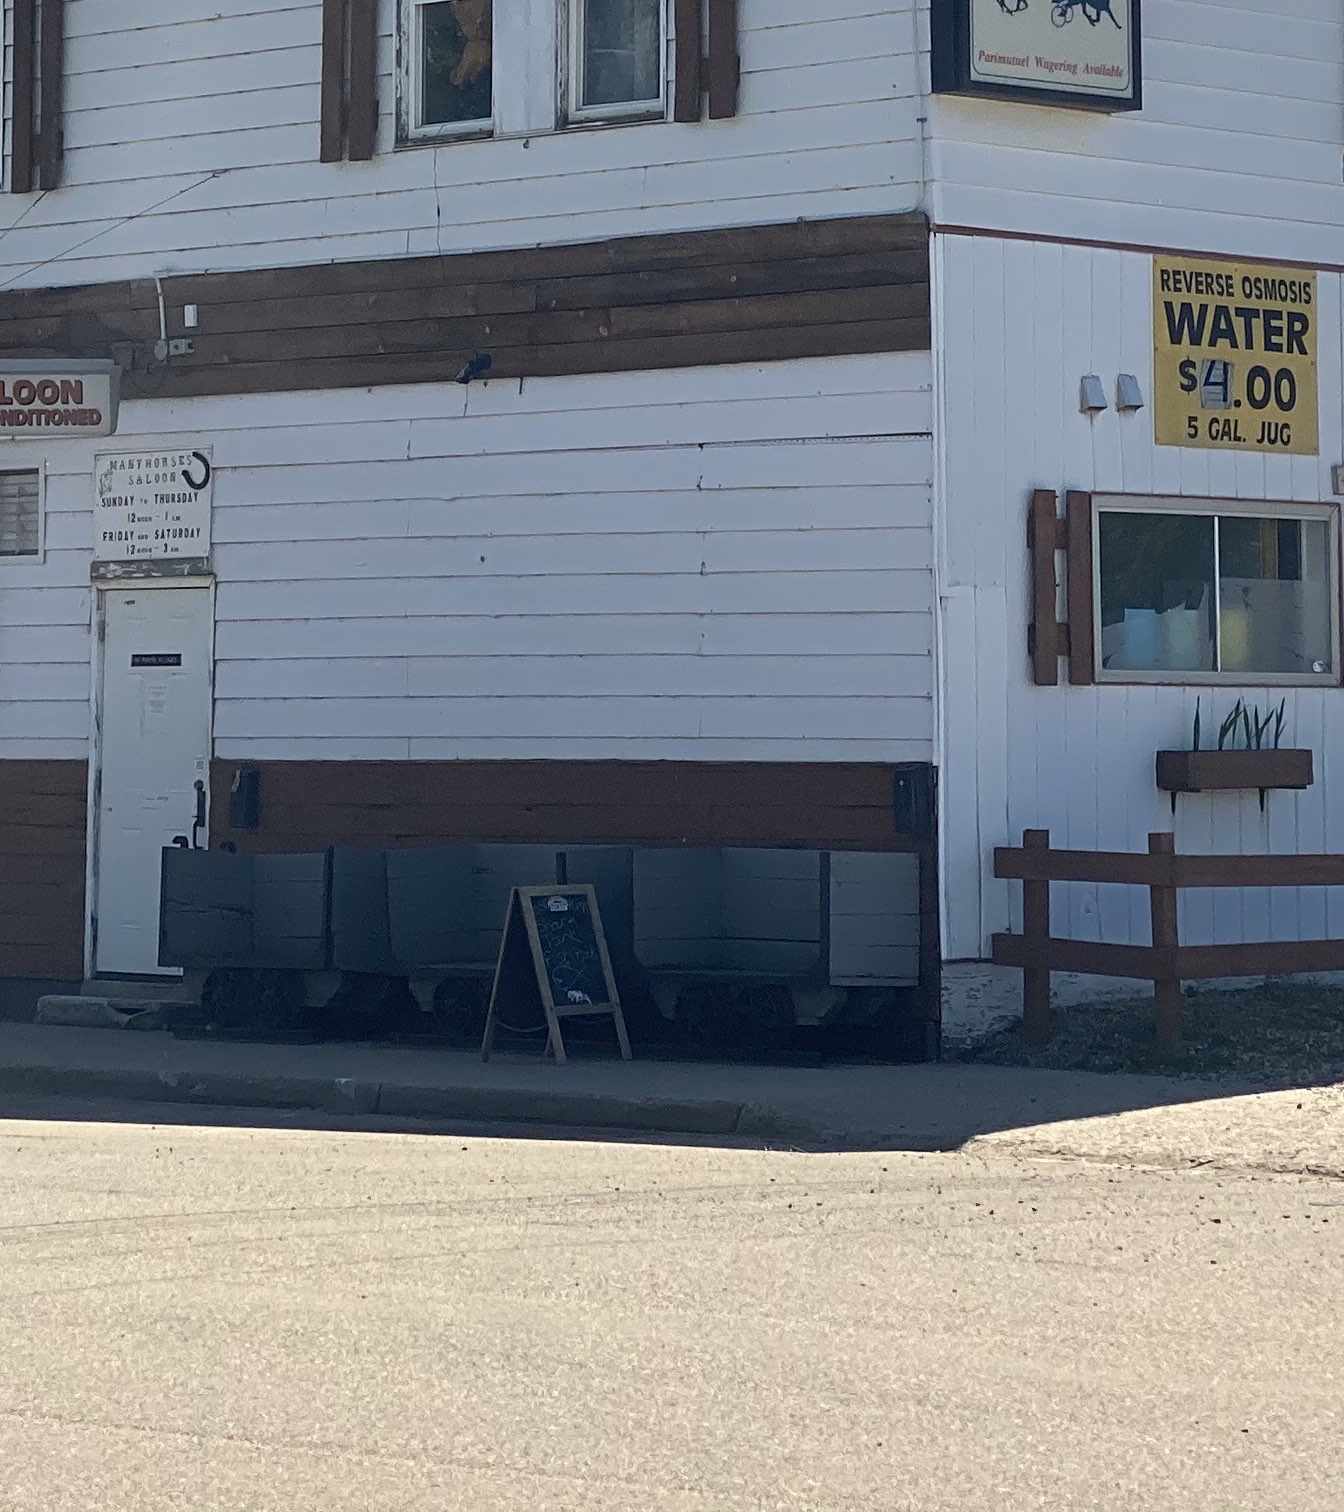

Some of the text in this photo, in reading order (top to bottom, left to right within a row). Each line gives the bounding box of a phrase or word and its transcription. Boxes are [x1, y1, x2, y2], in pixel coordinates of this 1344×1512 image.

[1035, 56, 1078, 74] Wagering
[1083, 62, 1123, 78] Available
[1160, 269, 1312, 304] REVERSE OSMOSIS
[1163, 301, 1310, 355] WATER
[1179, 355, 1297, 412] $4.00
[1188, 416, 1291, 446] 5 GAL. JUG
[109, 455, 193, 471] MANYHORSES
[128, 471, 176, 486] SALOON
[101, 495, 134, 507] SUNDAY
[154, 492, 199, 504] THURSDAY
[127, 513, 136, 523] 12
[102, 530, 134, 541] FRIDAY
[154, 528, 201, 540] SATURDAY
[126, 545, 135, 555] 12
